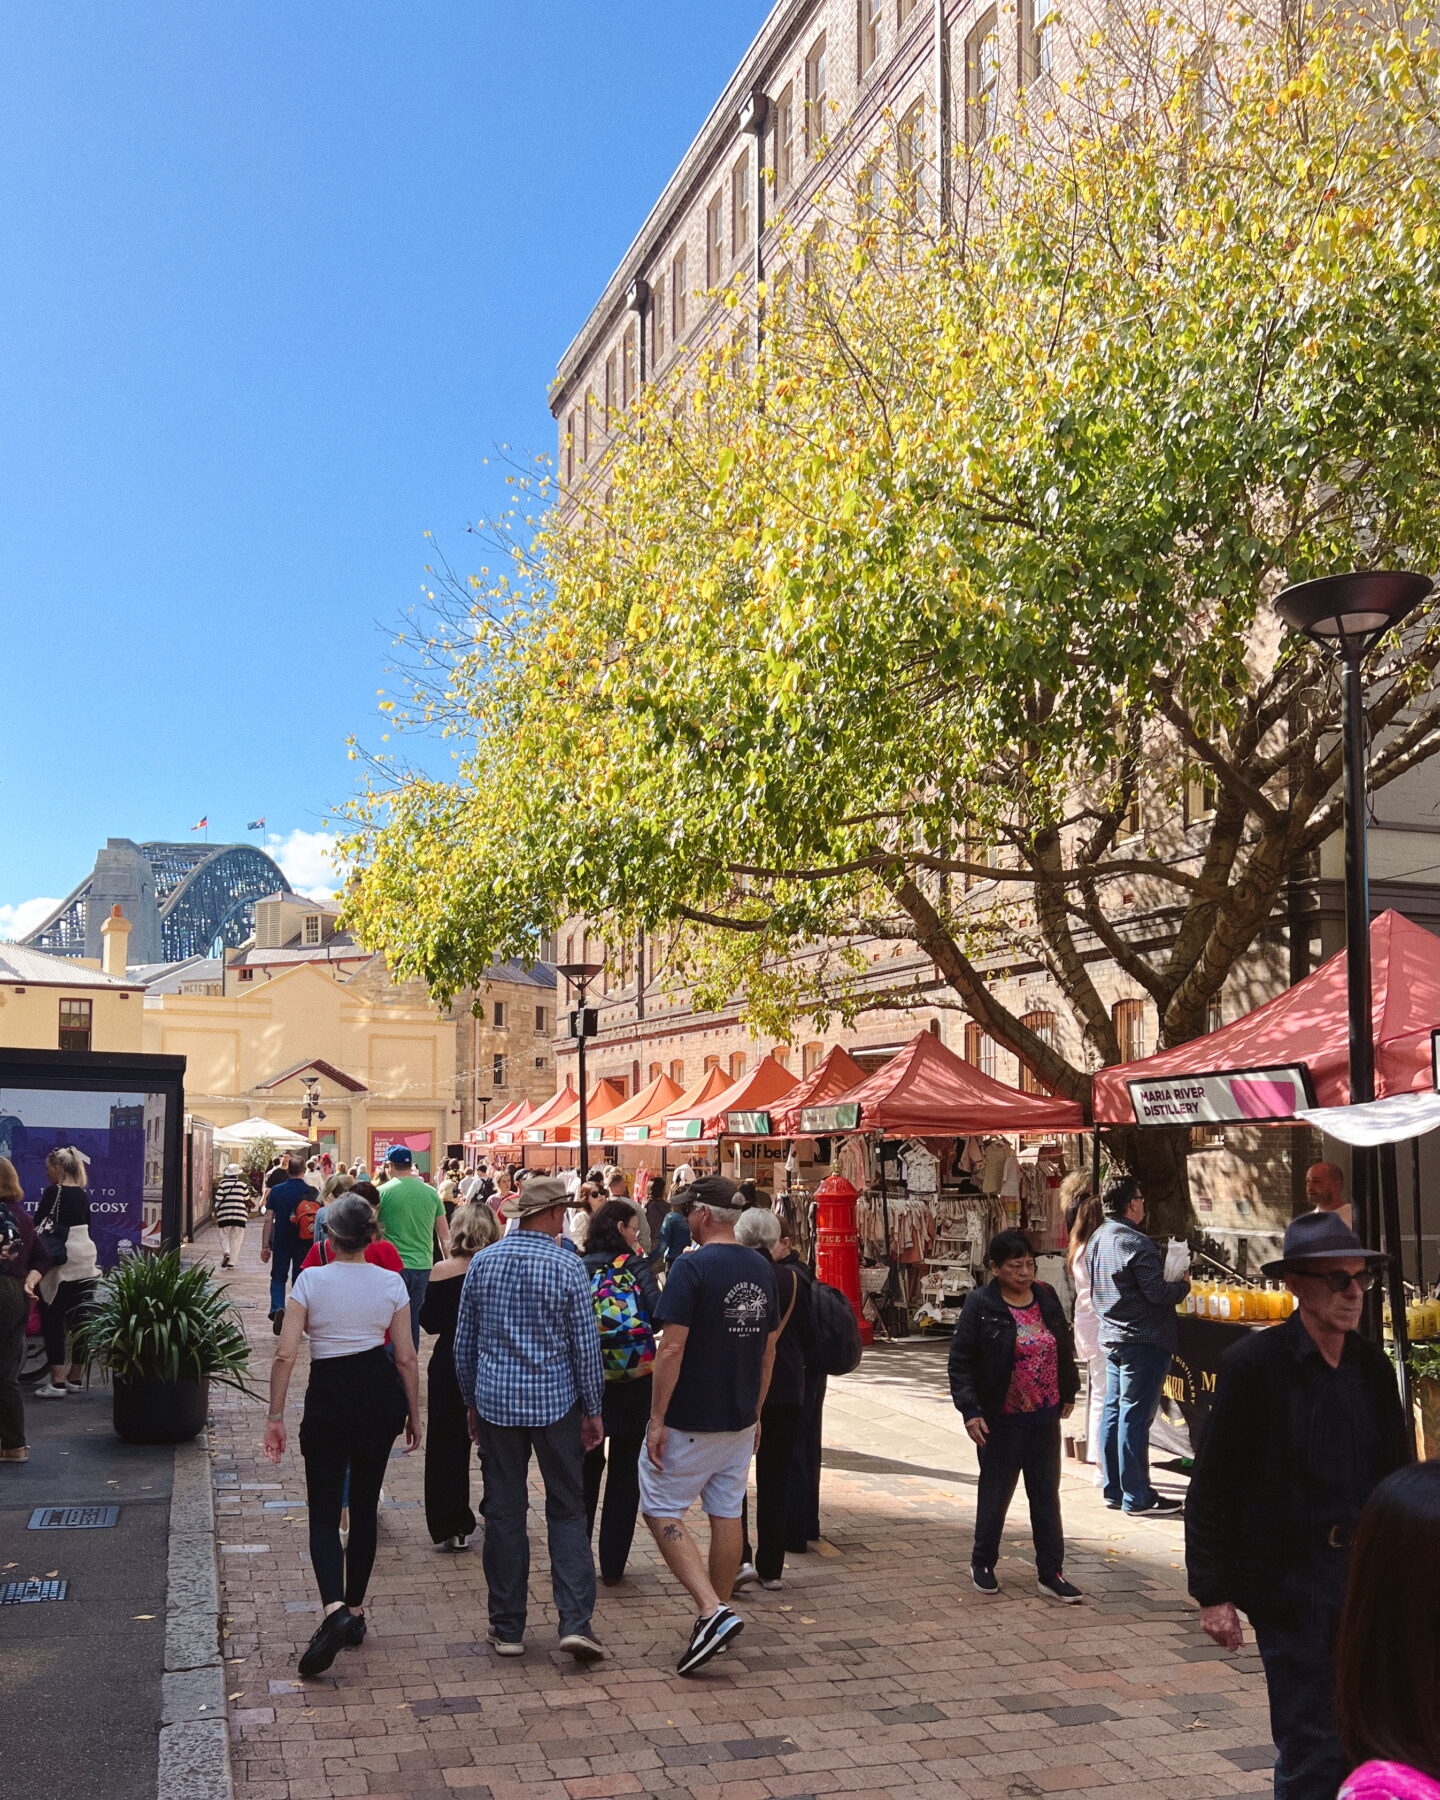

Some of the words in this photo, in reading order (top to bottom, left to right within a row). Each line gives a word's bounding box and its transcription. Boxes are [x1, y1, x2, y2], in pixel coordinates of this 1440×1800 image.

[1141, 1090, 1172, 1102] MARIA
[1174, 1087, 1205, 1099] RIVER
[1144, 1102, 1199, 1116] DISTILLERY
[101, 1188, 116, 1197] TO
[89, 1202, 129, 1213] COSY
